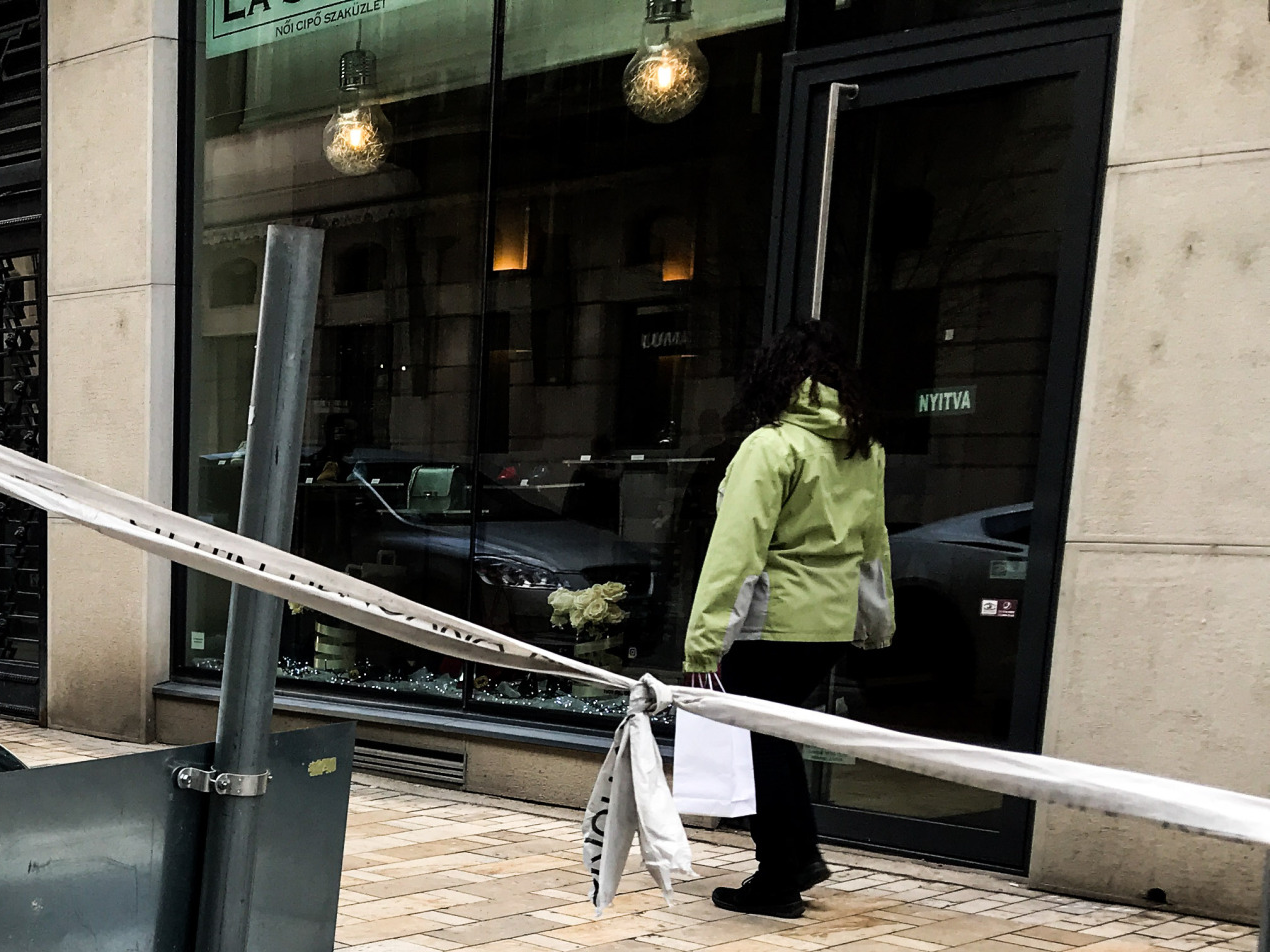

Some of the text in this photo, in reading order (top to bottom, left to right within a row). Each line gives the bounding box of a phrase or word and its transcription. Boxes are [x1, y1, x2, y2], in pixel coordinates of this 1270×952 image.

[275, 19, 294, 37] NŐI
[296, 11, 321, 31] CIPŐ
[919, 390, 971, 412] NYITVA
